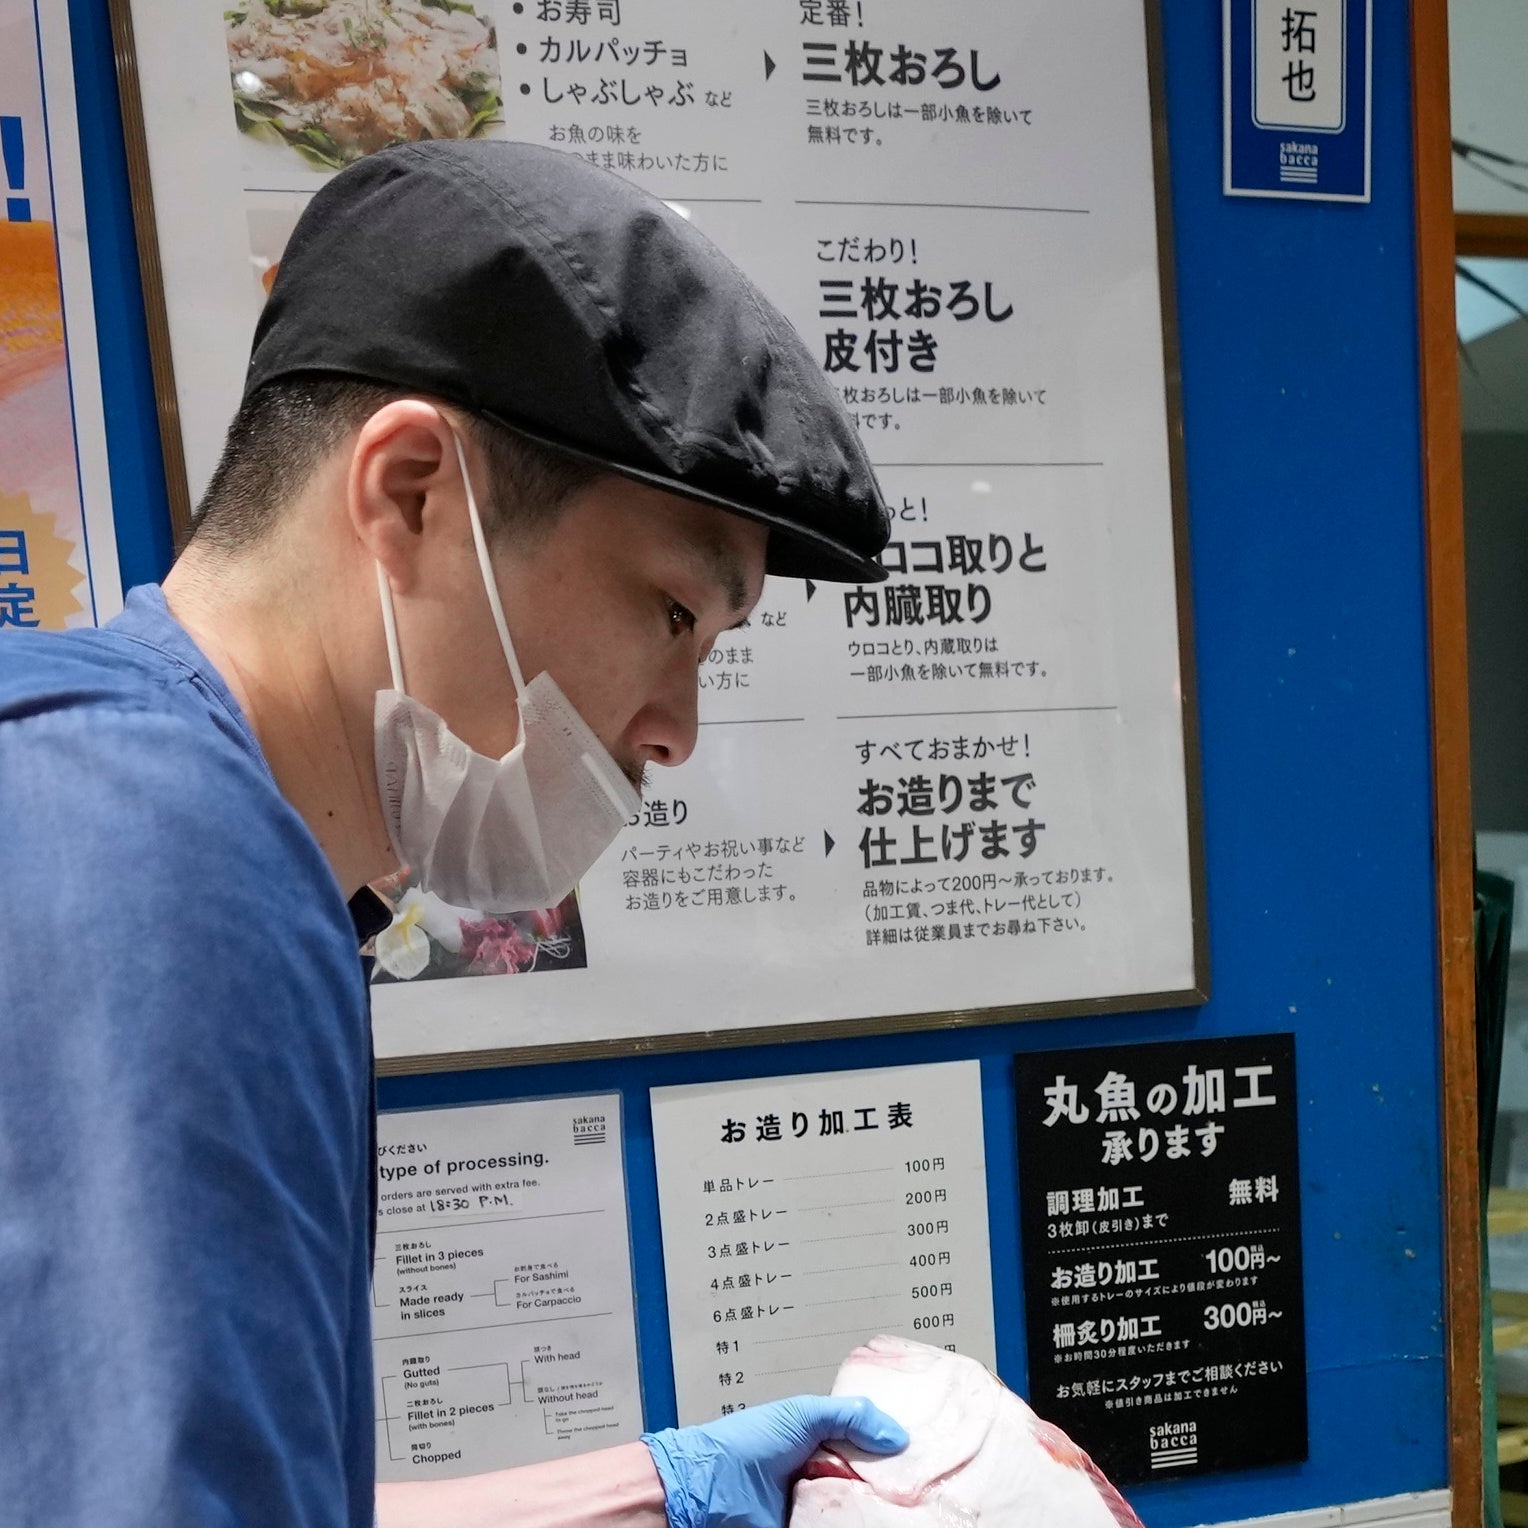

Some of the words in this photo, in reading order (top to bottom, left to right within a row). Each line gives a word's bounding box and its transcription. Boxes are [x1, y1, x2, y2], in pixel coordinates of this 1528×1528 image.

[536, 0, 621, 26] お寿司
[539, 36, 688, 67] カルパッチョ
[1281, 7, 1317, 101] 拓也
[802, 39, 1001, 92] 三枚おろし
[542, 77, 696, 108] しゃぶしゃぶ
[704, 90, 732, 108] など
[805, 98, 1033, 126] 三枚おろしは一部小魚を除いて
[549, 124, 643, 145] お魚の味を
[807, 124, 882, 146] 無料です。
[1280, 141, 1318, 154] sakana
[1280, 152, 1318, 166] bacca
[819, 275, 1014, 323] 三枚おろし
[823, 327, 939, 374] 皮付き
[760, 611, 788, 627] など
[843, 582, 992, 629] 内臓取り
[701, 646, 754, 666] のまま
[850, 660, 1047, 683] 一部小魚を除いて無料です。
[855, 733, 1030, 765] すべておまかせ！
[857, 771, 1037, 817] お造りまで
[621, 835, 805, 862] パーティやお祝い事など
[858, 818, 1046, 869] 仕上げます
[622, 861, 774, 889] 容器にもこだわった
[625, 885, 797, 912] お造りをご用意します。
[866, 917, 1086, 946] 詳細は従業員までお尋ね下さい。
[1042, 1064, 1277, 1128] 丸魚の加工
[572, 1115, 606, 1126] sakana
[573, 1123, 606, 1133] bacca
[720, 1101, 914, 1145] お造り加工表
[1101, 1122, 1226, 1166] 承ります
[379, 1164, 417, 1182] type
[423, 1160, 441, 1175] of
[447, 1152, 549, 1176] processing.
[702, 1176, 775, 1194] 単品トレー
[904, 1156, 946, 1174] 100円
[380, 1190, 414, 1202] orders
[416, 1189, 432, 1198] are
[435, 1185, 469, 1196] served
[471, 1183, 492, 1193] with
[494, 1180, 520, 1190] extra
[522, 1178, 541, 1188] fee.
[1046, 1185, 1145, 1217] 調理加工
[1228, 1175, 1280, 1206] 無料
[386, 1205, 414, 1216] close
[416, 1204, 426, 1213] at
[704, 1208, 789, 1228] 2点盛トレー
[905, 1188, 948, 1206] 200円
[707, 1240, 790, 1259] 3点盛トレー
[907, 1219, 950, 1238] 300円
[395, 1252, 423, 1266] Fillet
[425, 1252, 435, 1262] in
[437, 1250, 445, 1261] 3
[447, 1247, 484, 1262] pieces
[396, 1265, 428, 1277] (without
[430, 1262, 457, 1272] bones)
[514, 1274, 530, 1284] For
[532, 1270, 569, 1282] Sashimi
[710, 1272, 793, 1291] 4点盛トレー
[909, 1250, 952, 1268] 400円
[1050, 1258, 1160, 1290] お造り加工
[399, 1294, 430, 1307] Made
[433, 1291, 464, 1304] ready
[516, 1300, 532, 1310] For
[534, 1295, 582, 1308] Carpaccio
[712, 1303, 795, 1324] 6点盛トレー
[911, 1282, 954, 1300] 500円
[400, 1311, 411, 1321] in
[413, 1307, 446, 1319] slices
[716, 1339, 740, 1354] 特1
[912, 1313, 955, 1331] 600円
[1052, 1314, 1163, 1349] 柵炙り加工
[534, 1354, 556, 1364] With
[558, 1351, 581, 1361] head
[403, 1366, 441, 1379] Gutted
[404, 1380, 419, 1390] (No
[421, 1378, 440, 1389] guts)
[718, 1371, 745, 1386] 特2
[1055, 1357, 1285, 1400] お気軽にスタッフまでご相談ください
[537, 1393, 574, 1405] Without
[576, 1390, 599, 1400] head
[1104, 1384, 1239, 1411] ※値引き商品は加工できません
[407, 1409, 435, 1421] Fillet
[437, 1408, 447, 1418] in
[449, 1407, 457, 1416] 2
[459, 1403, 495, 1416] pieces
[408, 1421, 428, 1432] (with
[429, 1418, 455, 1429] bones)
[1149, 1420, 1197, 1438] sakana
[1149, 1432, 1198, 1450] bacca
[412, 1450, 462, 1465] Chopped
